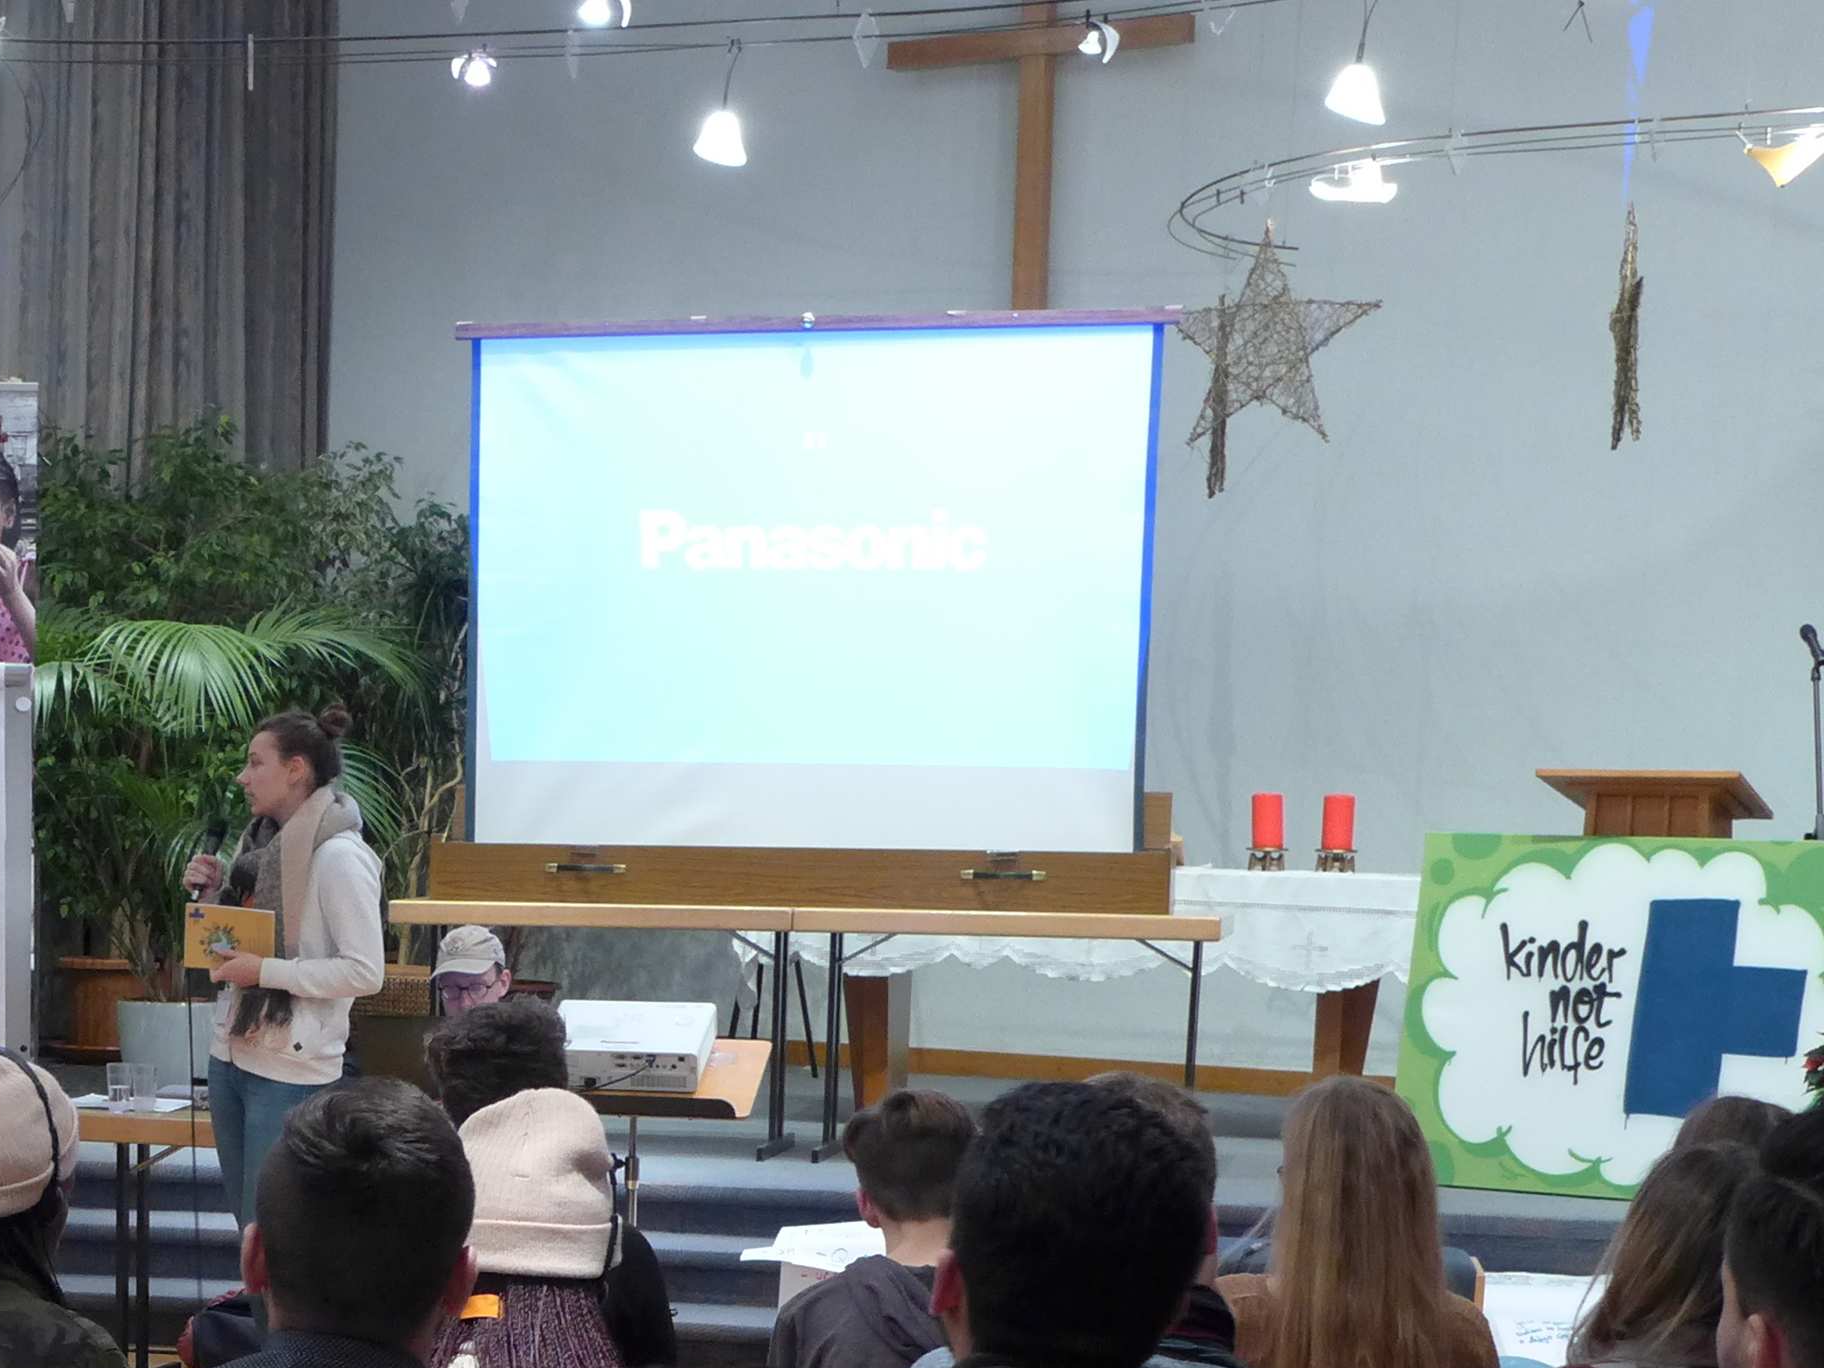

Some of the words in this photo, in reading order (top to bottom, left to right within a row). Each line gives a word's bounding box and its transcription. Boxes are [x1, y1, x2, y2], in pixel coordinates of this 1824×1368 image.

[637, 506, 988, 573] Panasonic
[1500, 918, 1628, 984] kinder
[1549, 980, 1623, 1029] not
[1521, 1011, 1606, 1086] hilfe
